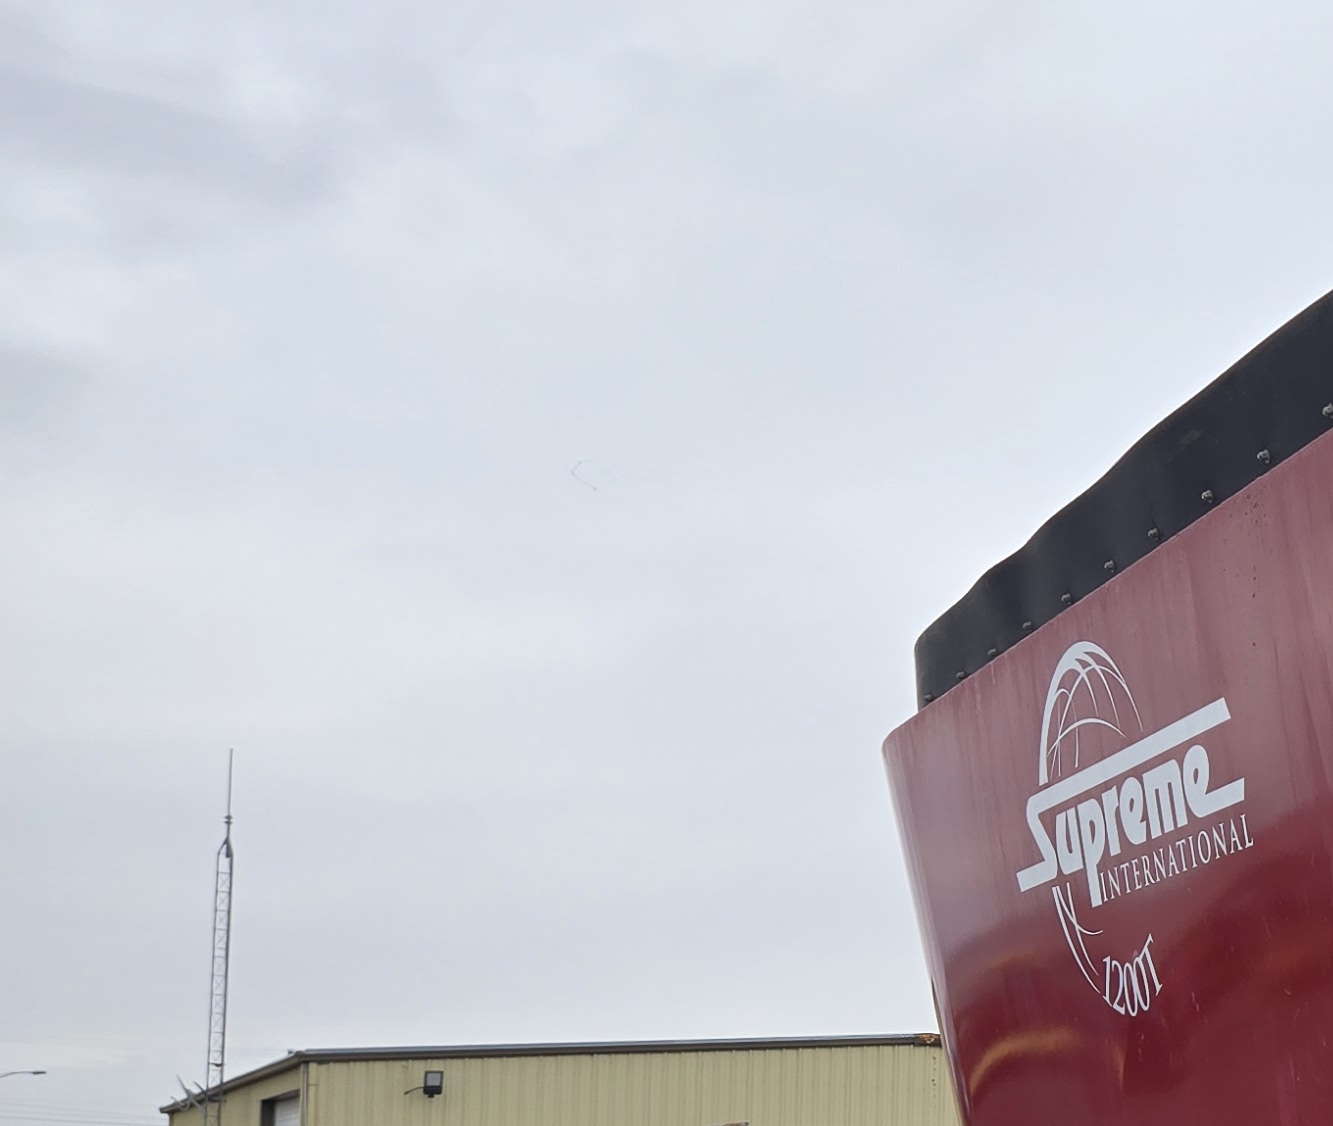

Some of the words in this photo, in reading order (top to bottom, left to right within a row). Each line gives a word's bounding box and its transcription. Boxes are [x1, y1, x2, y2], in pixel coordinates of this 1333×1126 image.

[1016, 697, 1245, 908] Supreme
[1100, 813, 1254, 903] INTERNATIONAL
[1102, 933, 1163, 1017] 1200T
